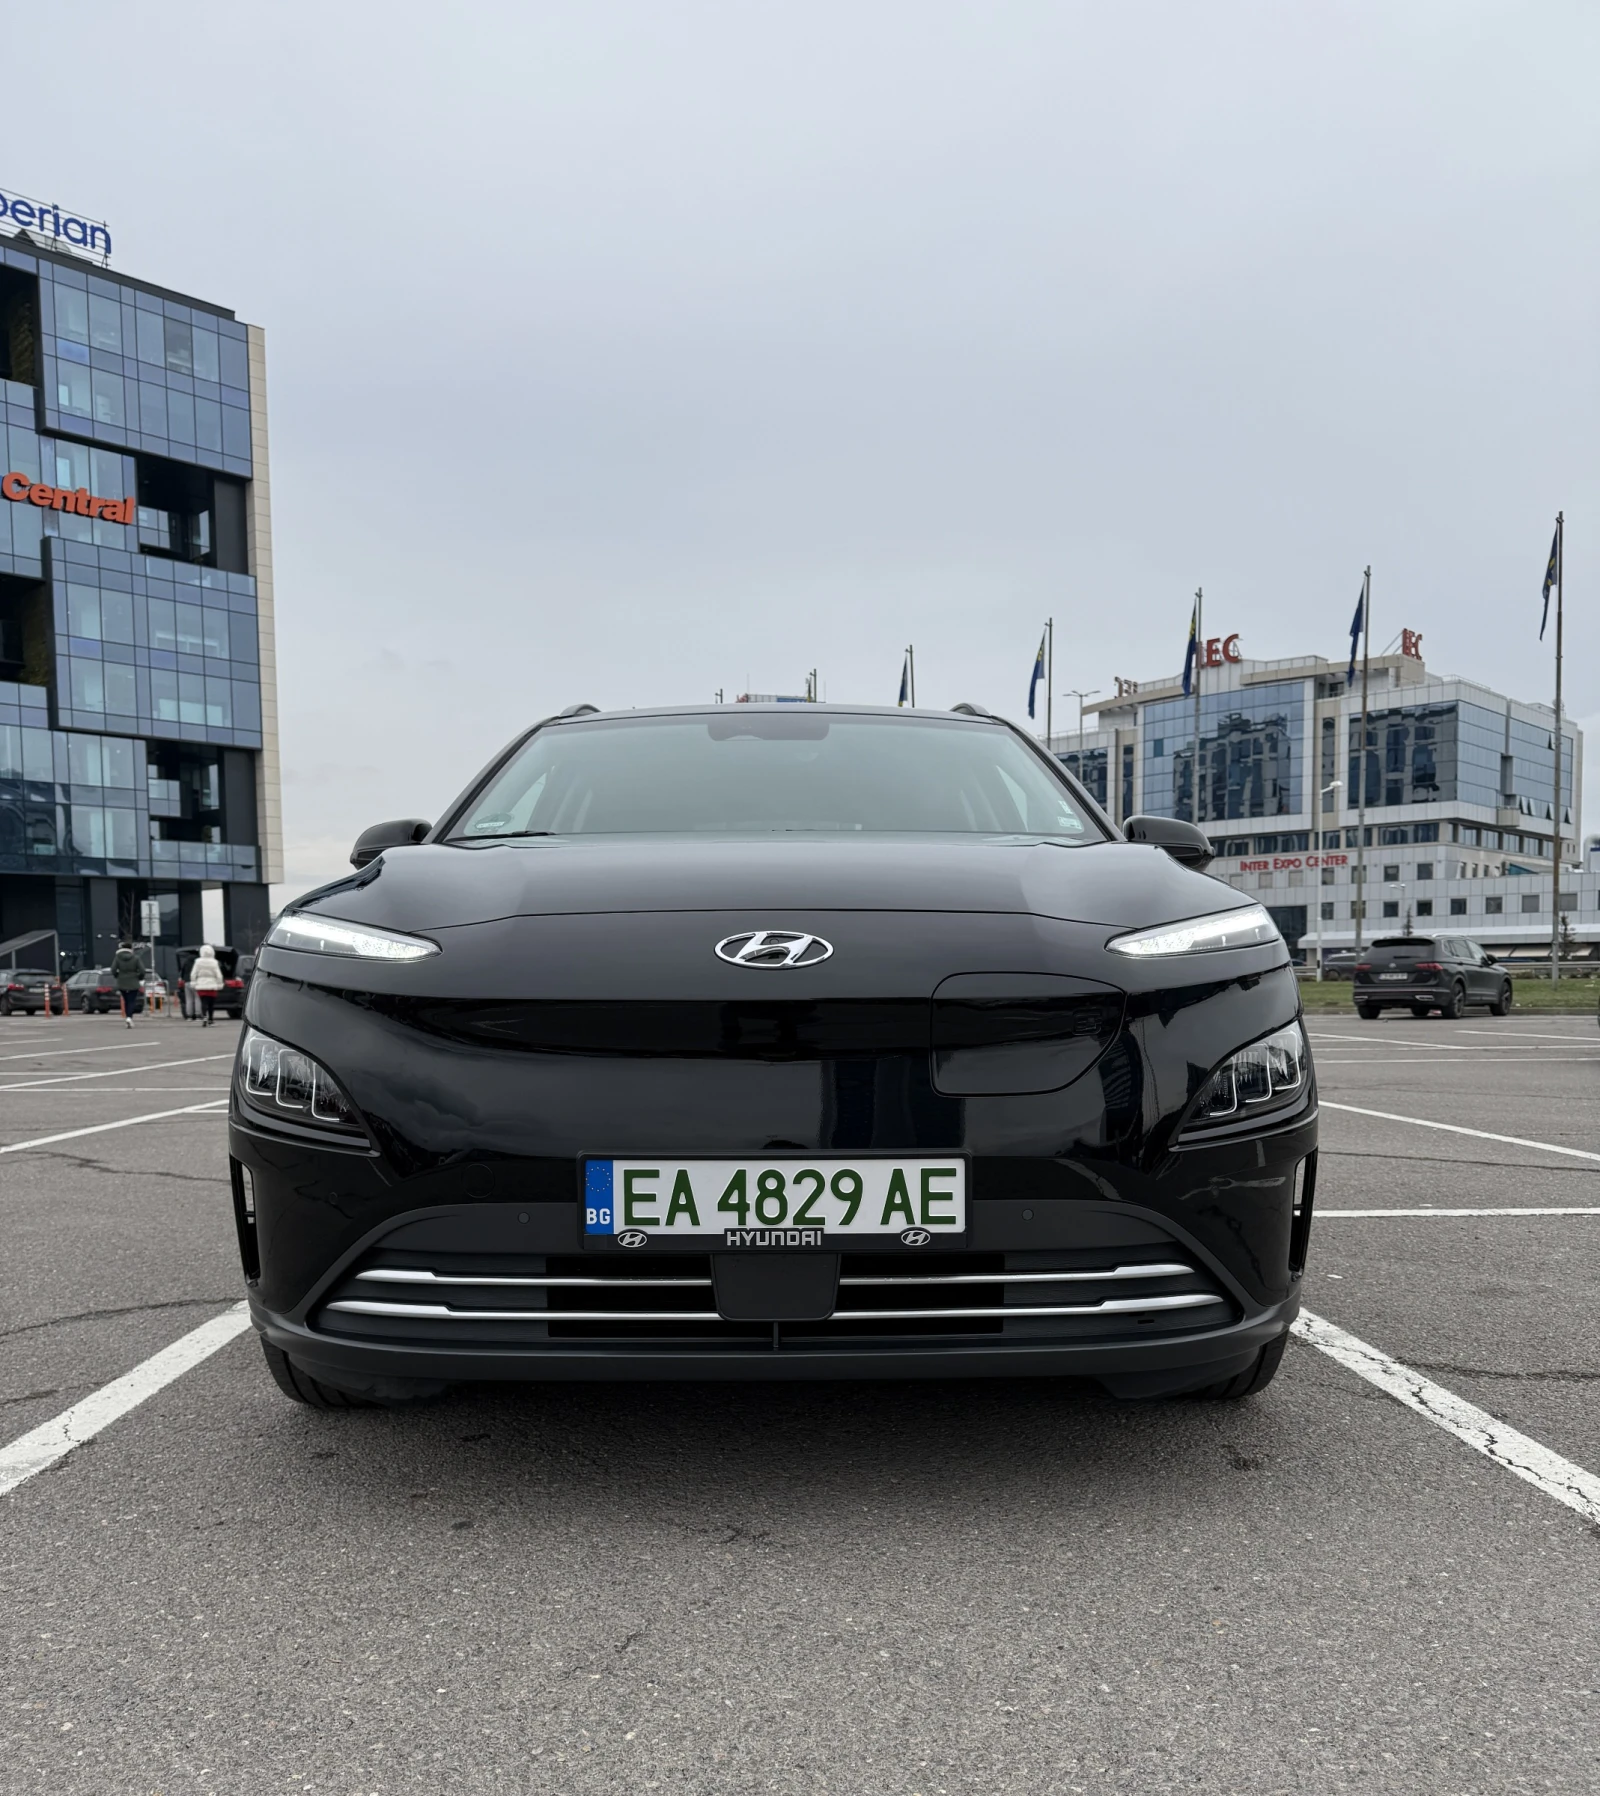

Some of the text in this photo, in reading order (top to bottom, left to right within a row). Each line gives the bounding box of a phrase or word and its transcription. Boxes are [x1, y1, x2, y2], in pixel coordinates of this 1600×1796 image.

[2, 472, 136, 524] Central
[1240, 855, 1348, 872] INTER EXPO CENTER
[622, 1167, 957, 1226] EA 4829 AE
[586, 1208, 611, 1225] BG
[726, 1230, 822, 1246] HYUNDAI
